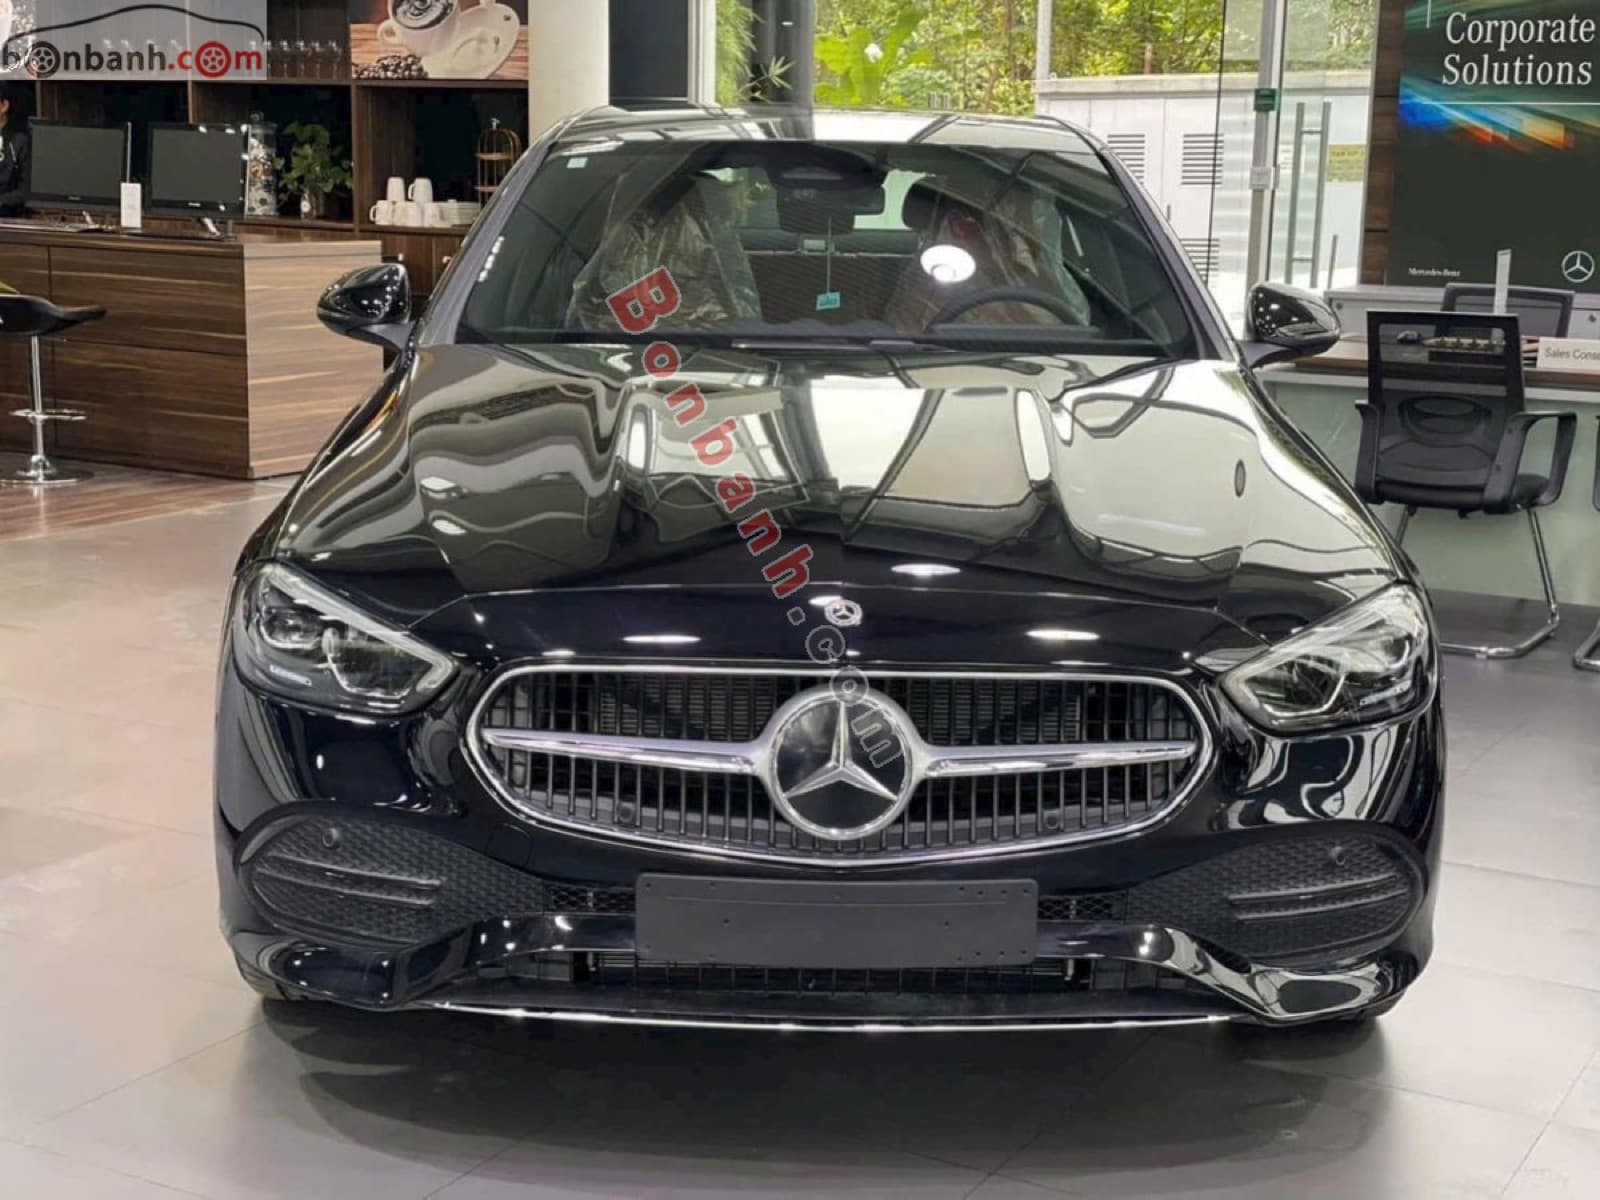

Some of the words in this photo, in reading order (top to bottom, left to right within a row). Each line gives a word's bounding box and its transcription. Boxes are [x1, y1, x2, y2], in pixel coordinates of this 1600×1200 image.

[1446, 11, 1596, 52] Corporate
[1442, 53, 1592, 86] Solutions
[1545, 347, 1569, 359] Sales
